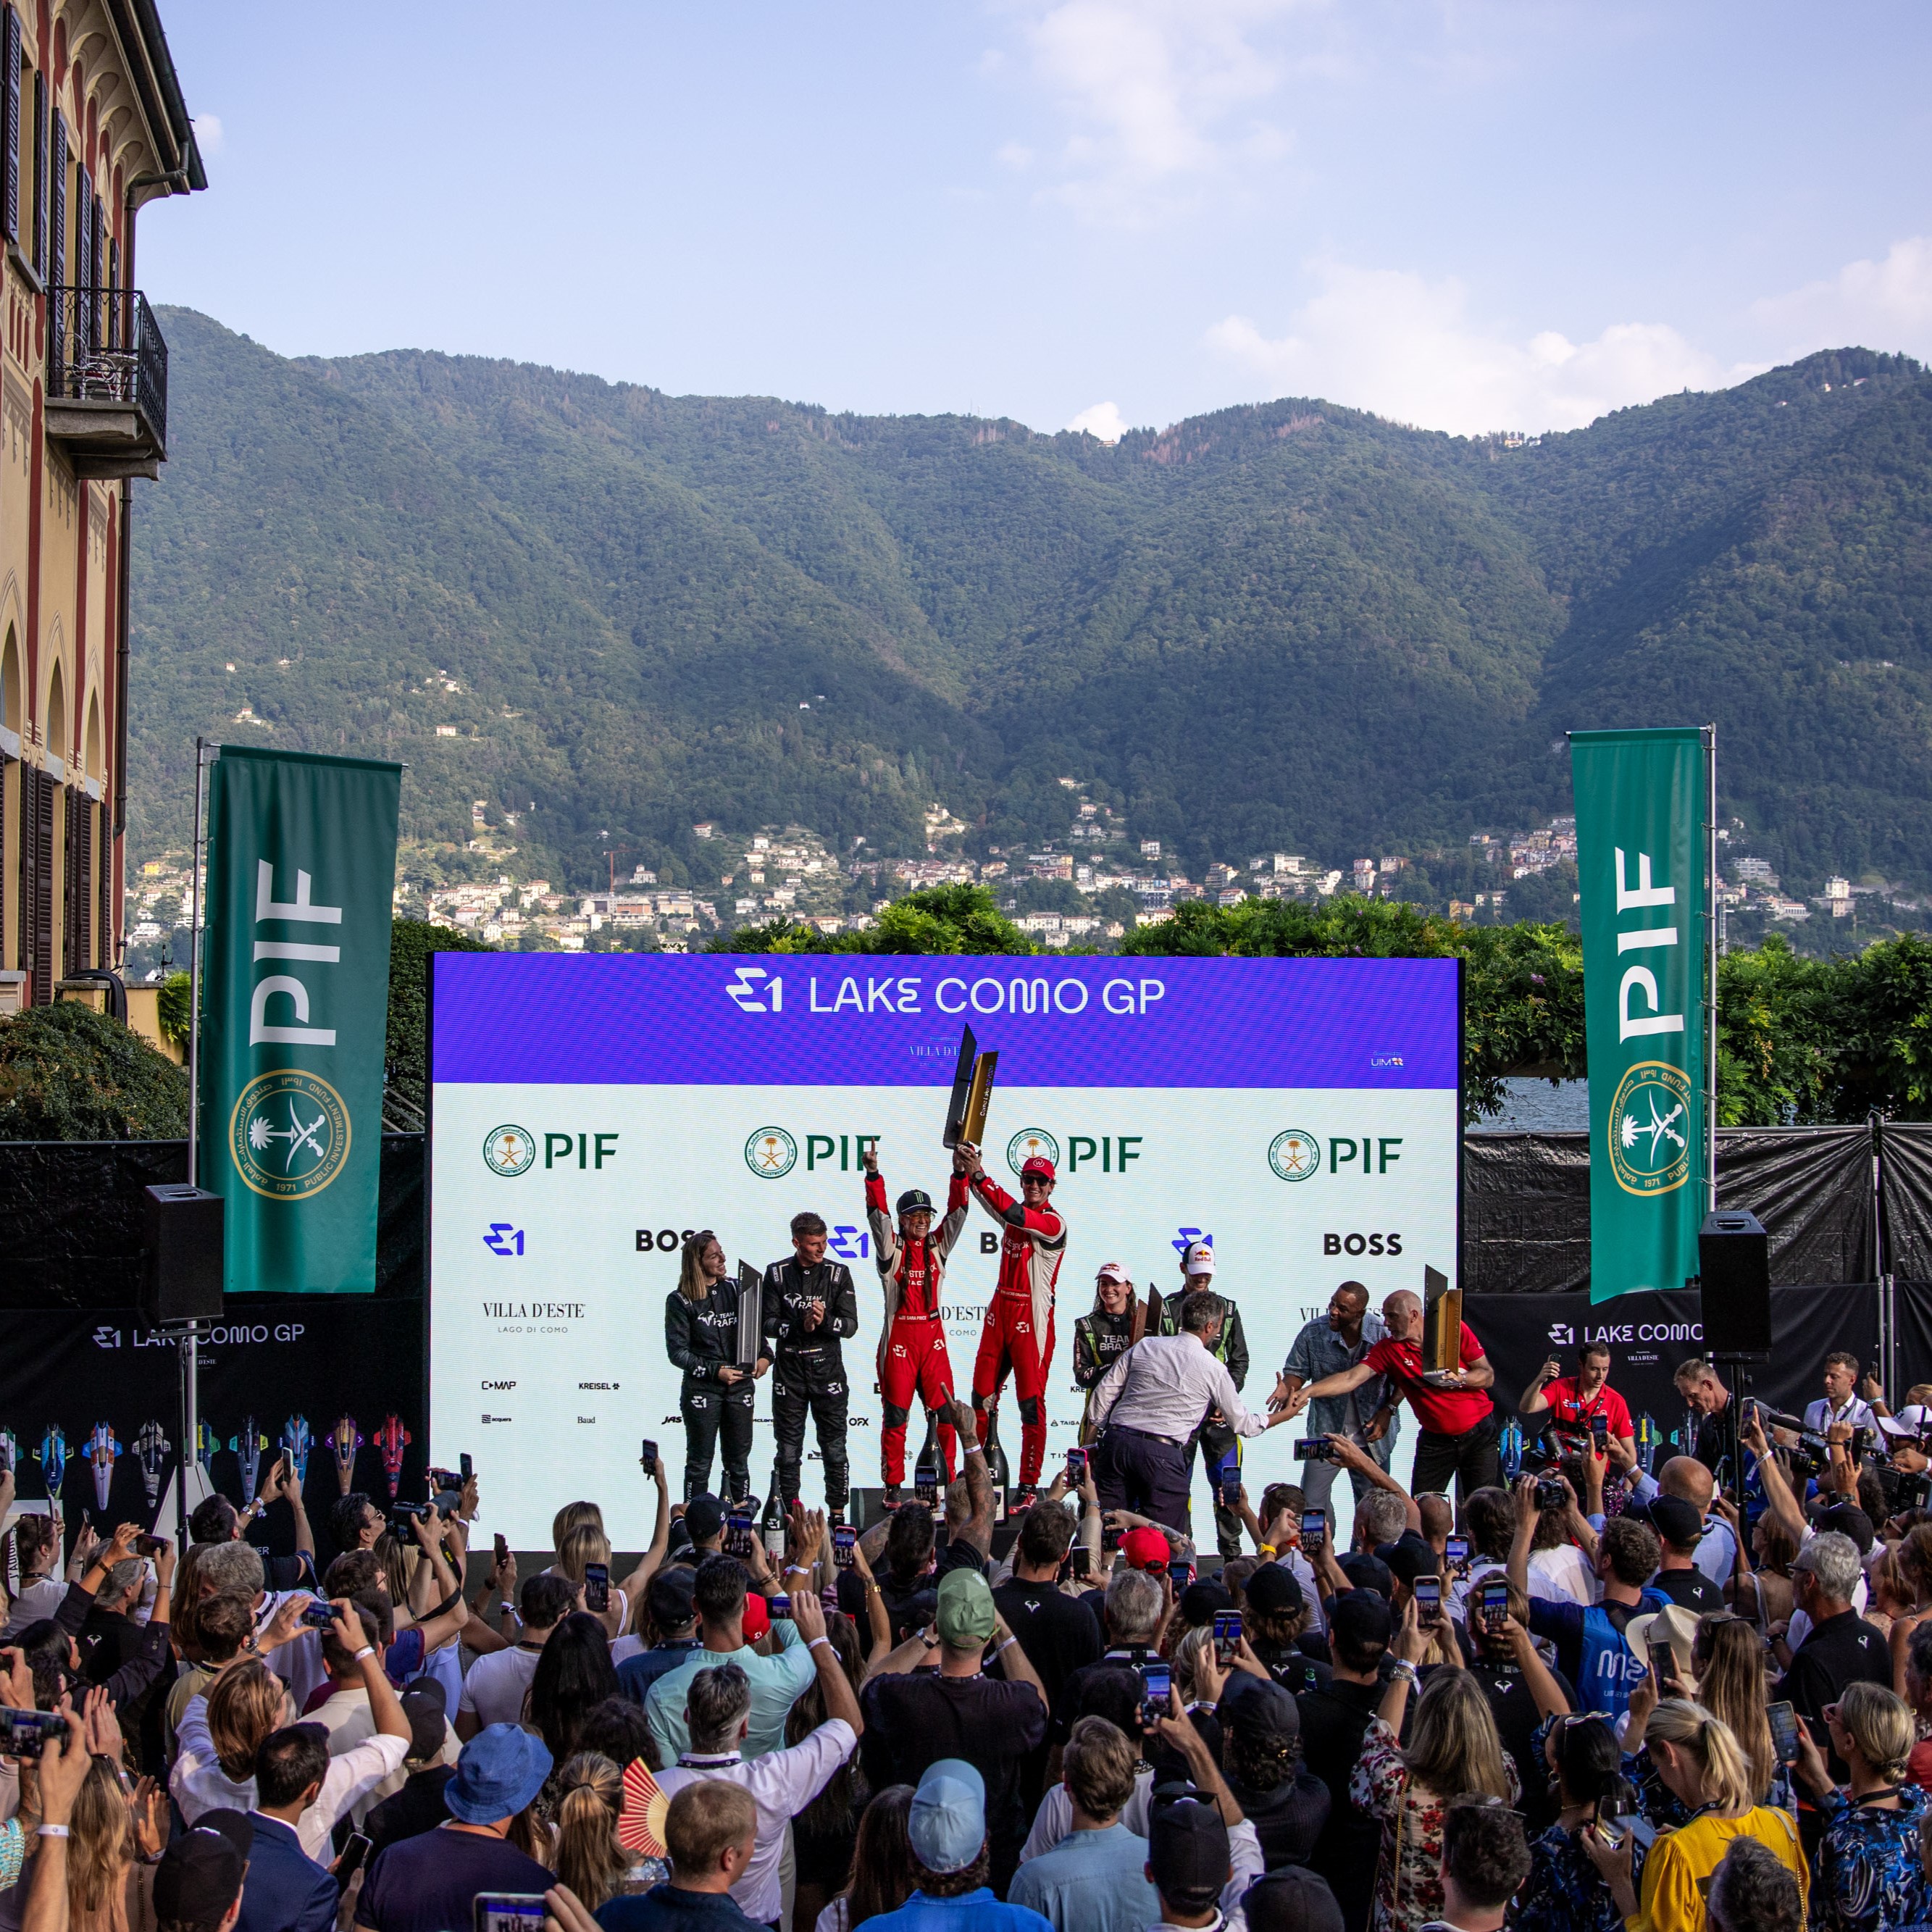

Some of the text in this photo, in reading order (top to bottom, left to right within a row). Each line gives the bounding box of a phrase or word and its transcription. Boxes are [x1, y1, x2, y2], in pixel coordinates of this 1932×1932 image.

[249, 858, 342, 1047] PIF
[1615, 847, 1684, 1045] PIF
[811, 977, 1165, 1014] LAKE COMO GP
[304, 1083, 344, 1188] PUBLIC INVESTMENT FUND
[544, 1133, 619, 1169] PIF
[806, 1135, 881, 1171] PIF
[1068, 1137, 1143, 1172] PIF
[1329, 1138, 1403, 1174] PIF
[276, 1183, 297, 1192] 1971
[1644, 1177, 1660, 1187] 1971
[1324, 1233, 1402, 1256] BOSS
[482, 1302, 585, 1318] VILLA D'ESTE
[719, 1311, 735, 1320] TEAM
[133, 1329, 188, 1347] LAK
[275, 1324, 305, 1342] GP
[1584, 1325, 1634, 1342] LAKE
